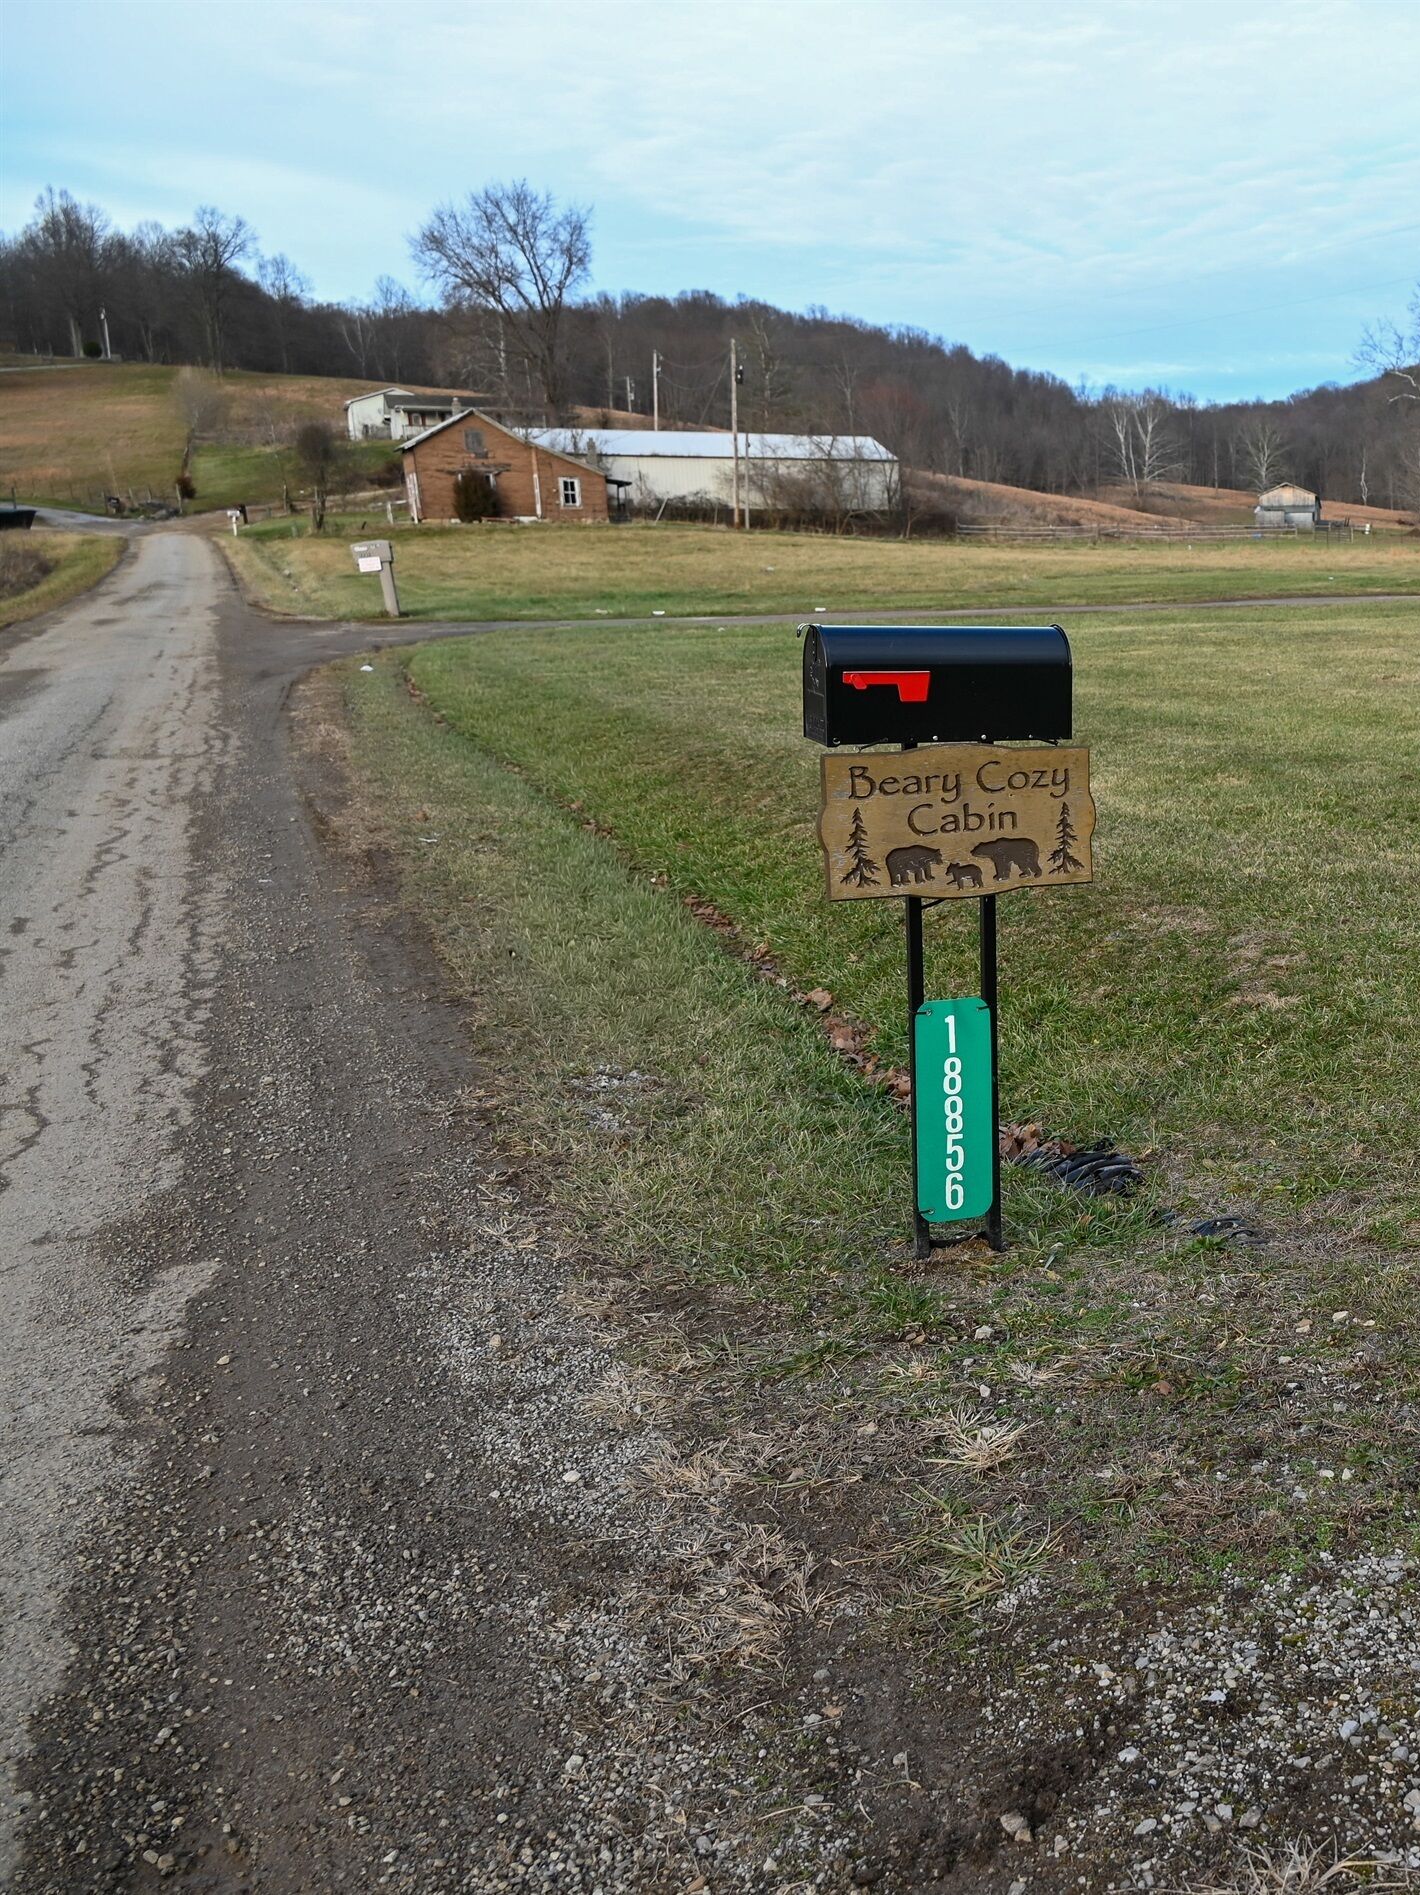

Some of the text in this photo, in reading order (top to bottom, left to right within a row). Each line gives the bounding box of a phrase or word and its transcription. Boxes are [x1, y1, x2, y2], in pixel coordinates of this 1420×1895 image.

[848, 760, 1071, 804] Beary Cozy
[907, 802, 1018, 837] Cabin
[942, 1014, 965, 1211] 18856
